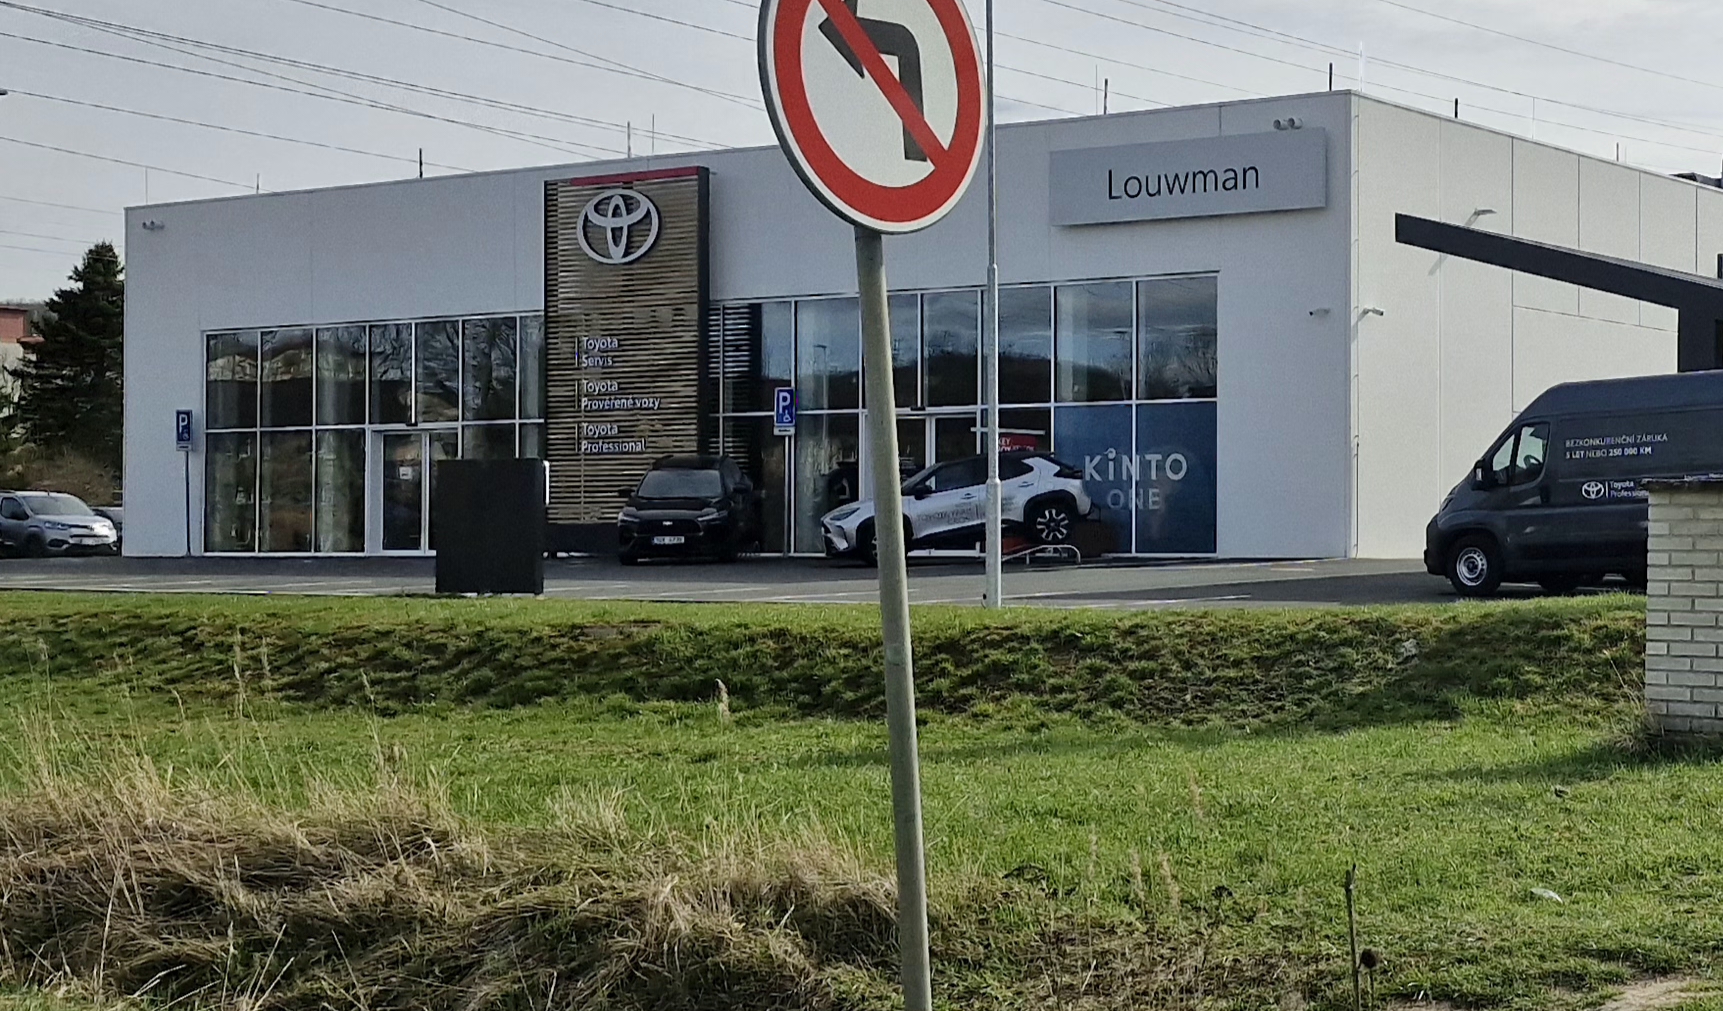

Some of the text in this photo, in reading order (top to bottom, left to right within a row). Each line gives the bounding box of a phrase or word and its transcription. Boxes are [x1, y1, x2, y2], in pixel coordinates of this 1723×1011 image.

[1108, 165, 1260, 200] Louwman
[582, 336, 619, 351] Toyota
[581, 353, 613, 367] Servis
[582, 380, 618, 395] Toyota
[635, 397, 660, 410] vozy
[581, 422, 618, 438] Toyota
[581, 437, 646, 453] Professional
[1640, 446, 1652, 455] KM
[1609, 480, 1635, 491] Toyota
[1107, 489, 1161, 510] ONE
